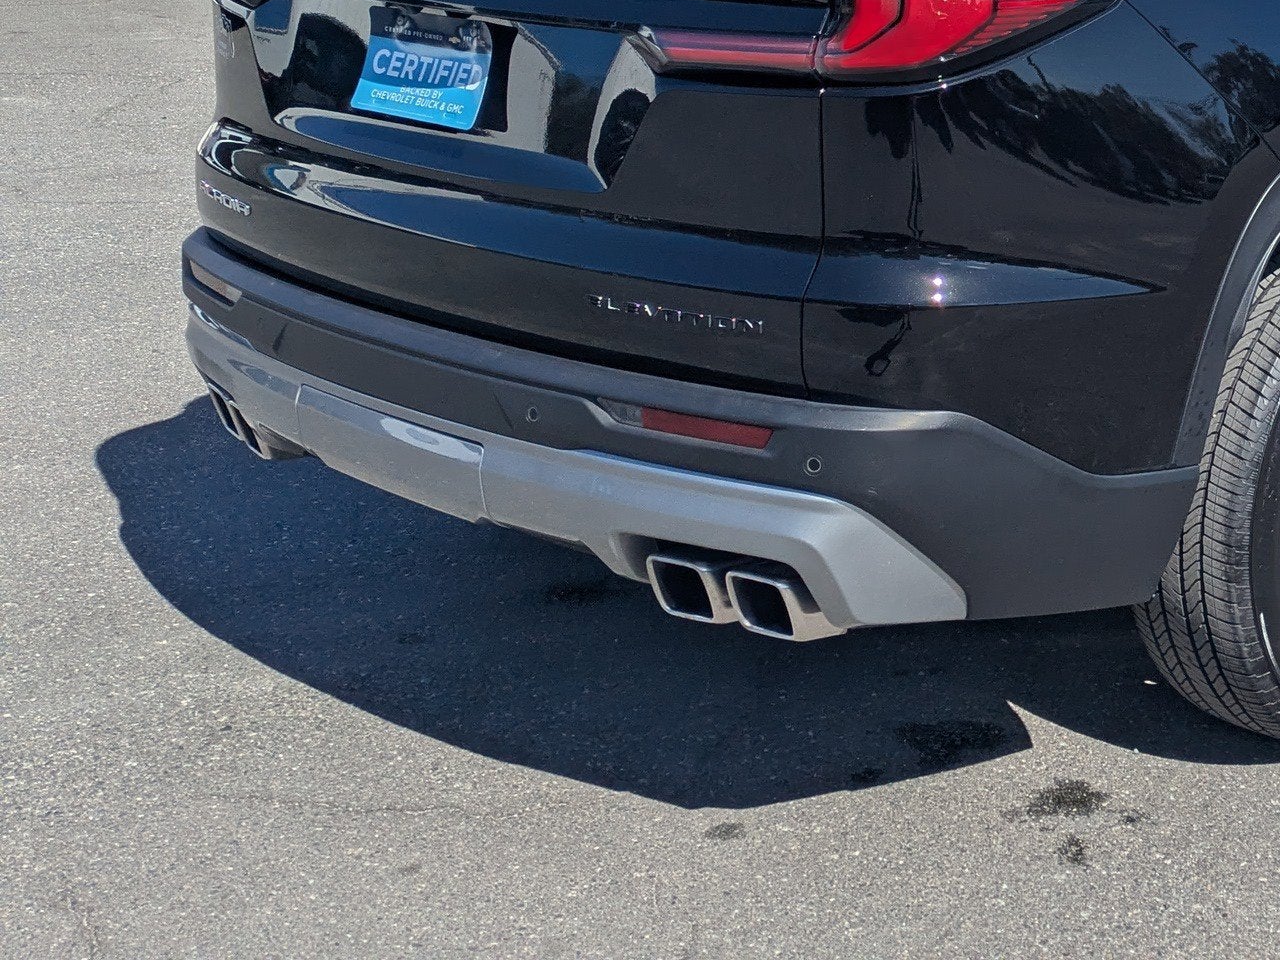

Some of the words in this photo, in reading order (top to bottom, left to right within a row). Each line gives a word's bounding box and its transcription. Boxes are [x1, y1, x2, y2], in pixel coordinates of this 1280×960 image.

[372, 48, 483, 88] CERTIFIED
[370, 88, 415, 105] CHEVROLET
[415, 97, 438, 109] BUICK
[439, 101, 445, 110] &
[446, 102, 465, 114] GMC
[400, 85, 430, 98] BACKED
[431, 89, 443, 99] BY
